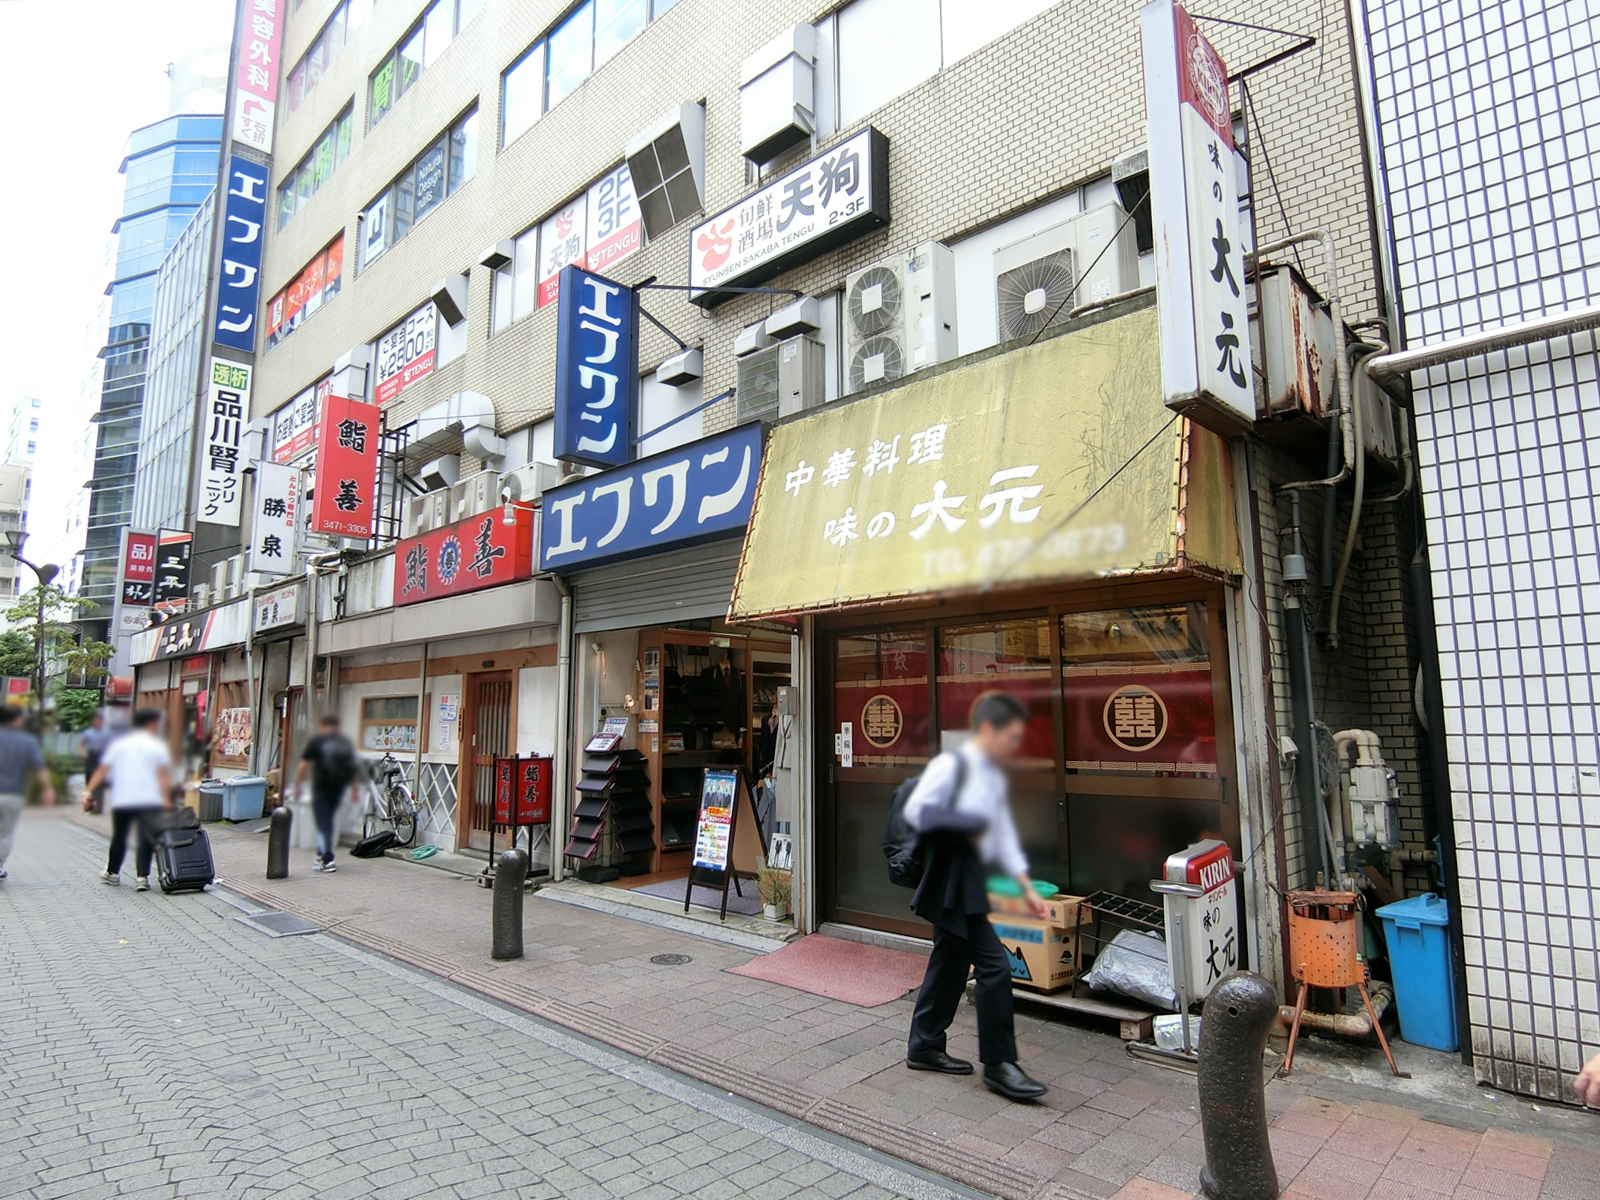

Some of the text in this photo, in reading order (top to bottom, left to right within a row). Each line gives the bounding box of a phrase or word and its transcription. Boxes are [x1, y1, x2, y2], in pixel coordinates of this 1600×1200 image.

[253, 121, 267, 145] 右折
[418, 169, 442, 197] Design
[419, 150, 443, 182] Natural
[417, 190, 433, 211] nails
[598, 166, 631, 211] 2F
[738, 192, 774, 228] 旬鮮
[776, 147, 860, 233] 天狗
[597, 194, 631, 239] 3F
[738, 216, 774, 254] 酒場
[218, 171, 265, 333] エフワン
[547, 233, 581, 276] 天狗
[601, 229, 640, 261] TENGU
[702, 222, 815, 287] SYUNSEN SAKABA TENGU
[1207, 141, 1247, 390] 味の大元
[215, 364, 247, 390] 透析
[380, 331, 425, 382] ¥2500
[410, 355, 434, 379] TENGU
[577, 276, 621, 454] エフワン
[210, 389, 243, 475] 品川腎
[334, 418, 368, 513] 鮨善
[784, 422, 949, 498] 中華料理
[204, 478, 221, 517] ニック
[222, 476, 237, 504] クリ
[285, 475, 297, 528] とんかつ専門店
[545, 445, 751, 562] エフワン
[822, 464, 1045, 548] 味の大元
[261, 497, 287, 558] 勝泉
[322, 519, 368, 536] 3471-3305
[1199, 855, 1231, 891] KIRIN
[1208, 886, 1228, 905] キリンビール
[1203, 907, 1221, 933] 味の
[1206, 926, 1236, 986] 大元
